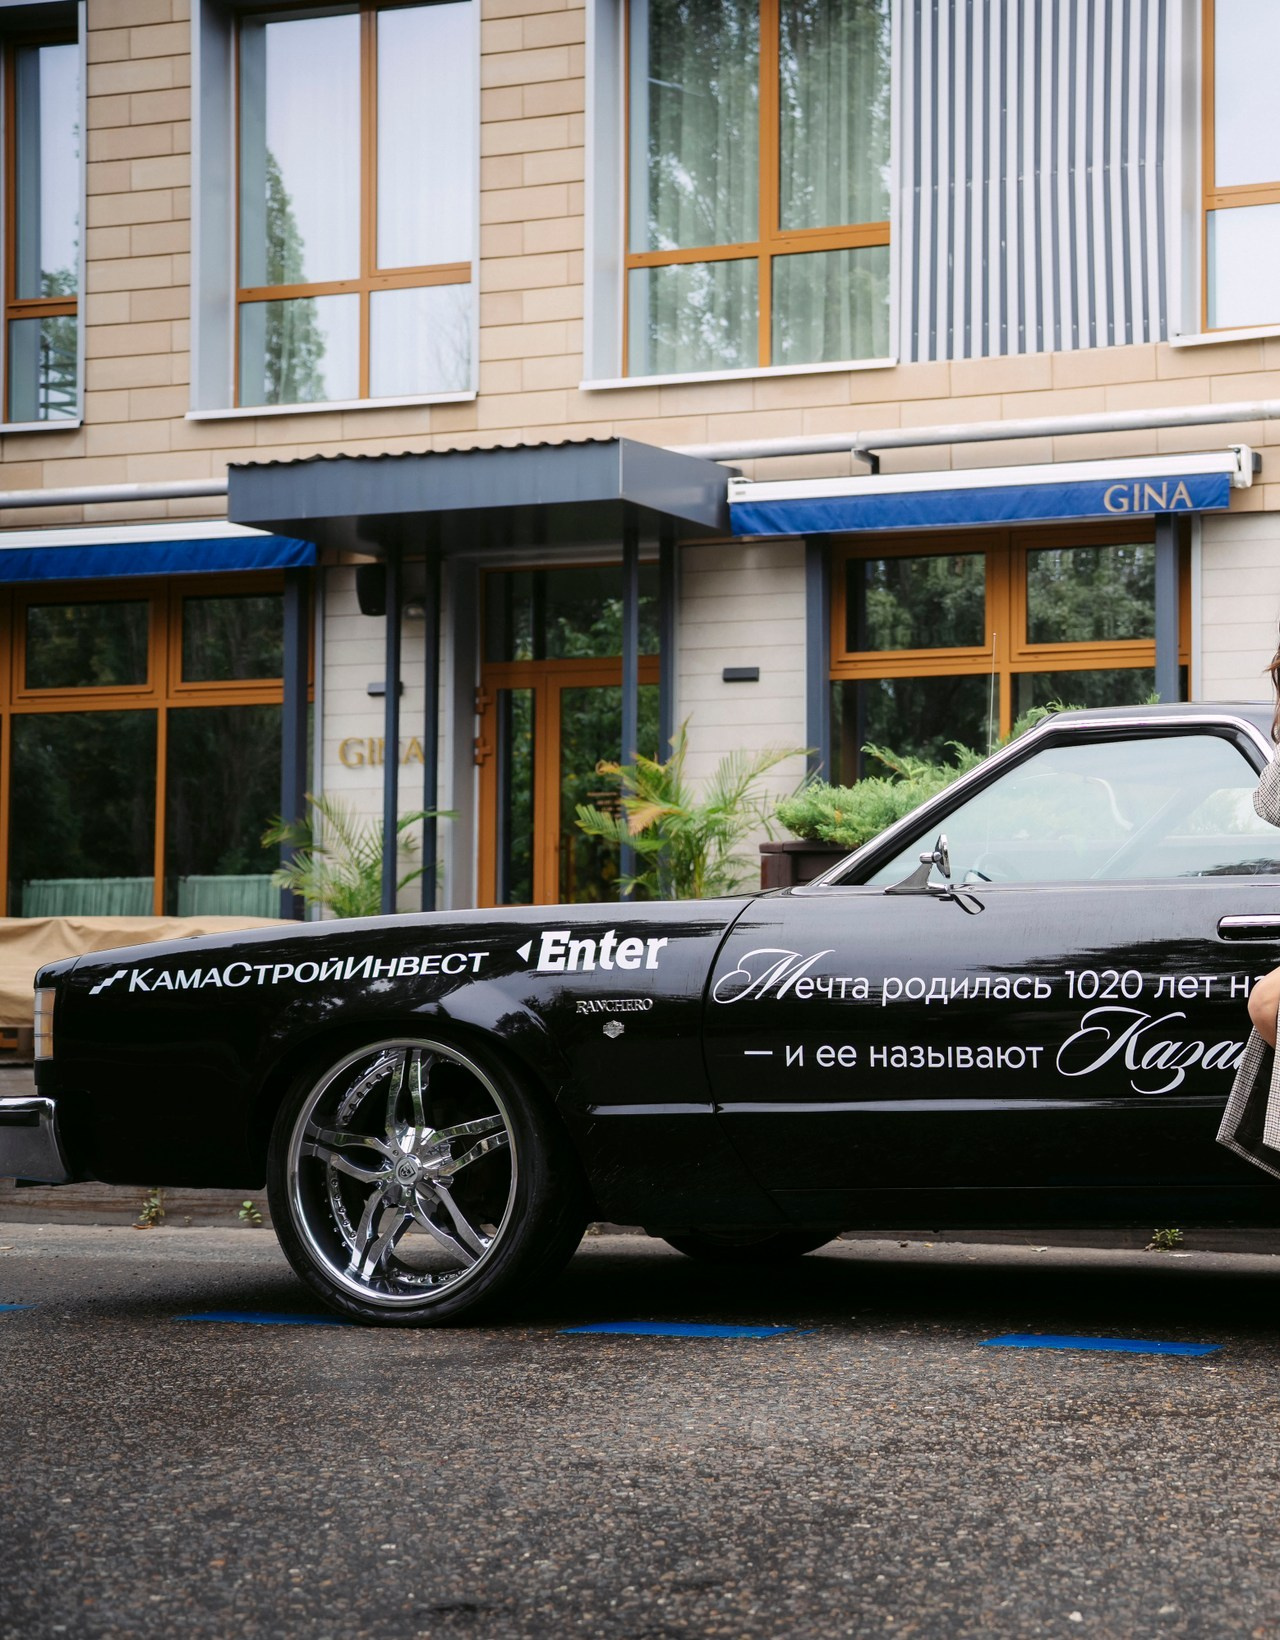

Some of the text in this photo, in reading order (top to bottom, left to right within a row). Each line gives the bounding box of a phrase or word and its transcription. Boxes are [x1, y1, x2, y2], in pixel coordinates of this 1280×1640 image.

[1103, 480, 1194, 513] GINA
[338, 736, 425, 770] GIA
[536, 929, 669, 972] Enter
[713, 948, 1266, 1007] Мечта родилась 1020 лет н
[575, 998, 654, 1015] RANCHERO
[785, 1045, 804, 1067] и
[816, 1045, 857, 1068] ее
[869, 1045, 1044, 1069] называют
